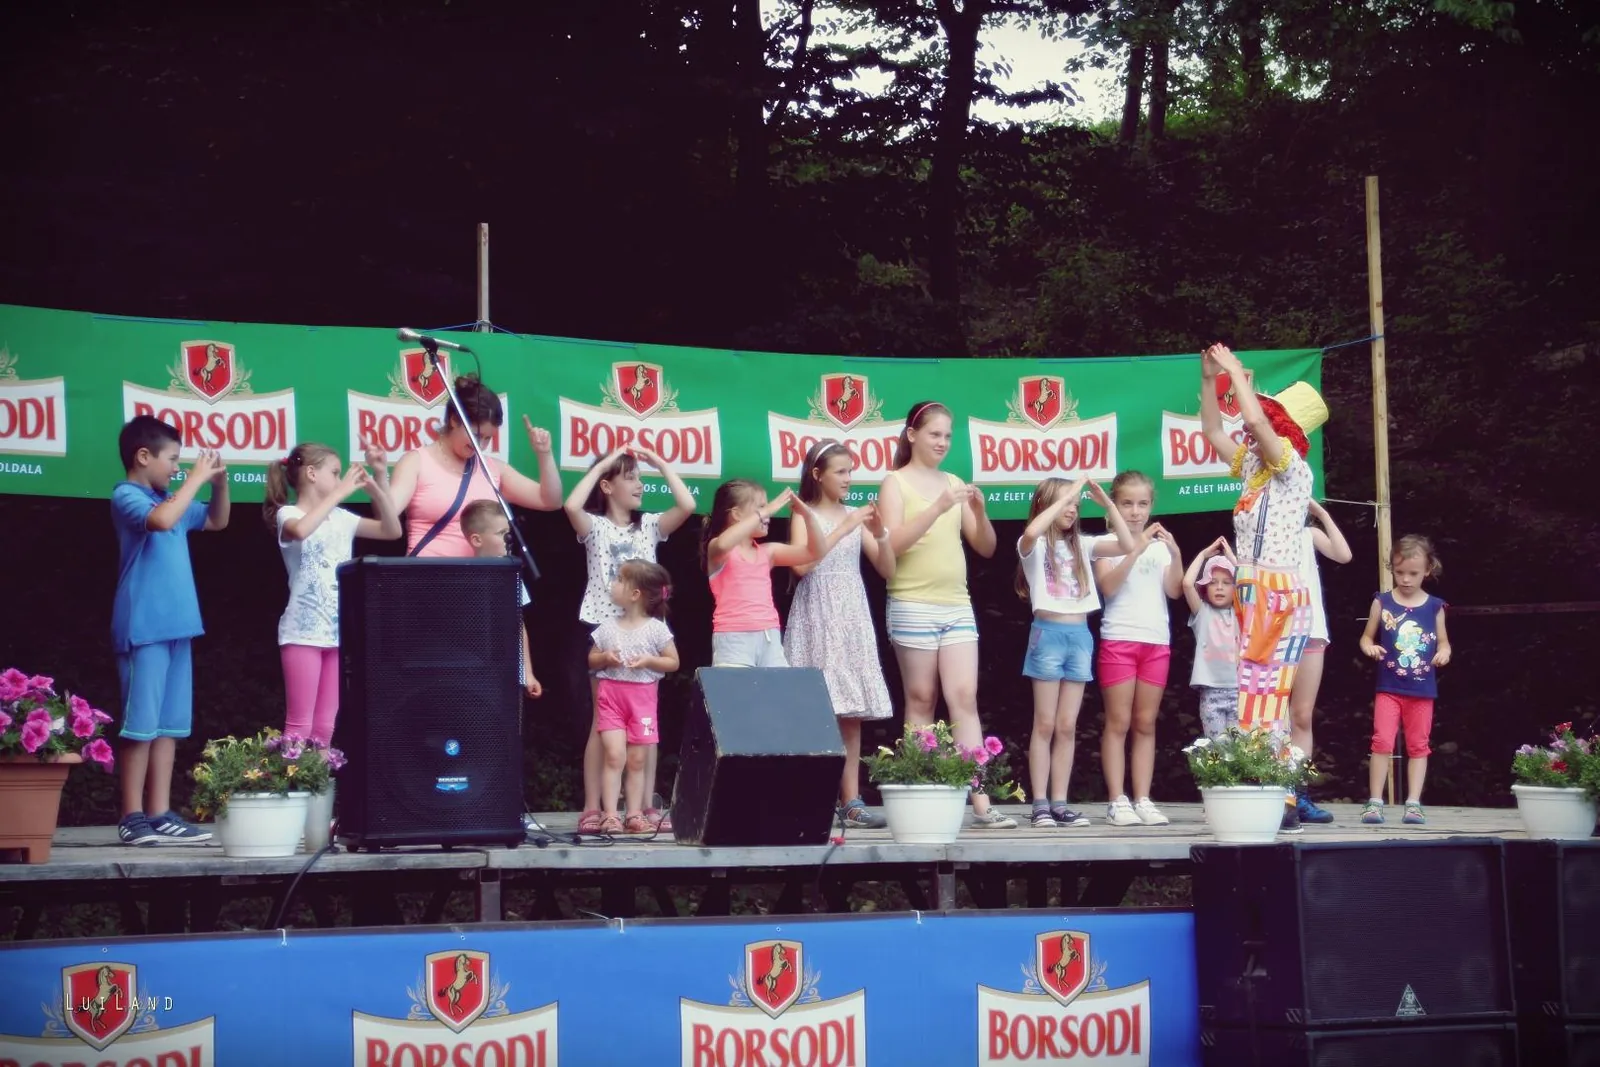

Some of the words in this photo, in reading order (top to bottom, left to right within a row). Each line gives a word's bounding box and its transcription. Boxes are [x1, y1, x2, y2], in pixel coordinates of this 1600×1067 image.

[978, 430, 1109, 472] BORSODI
[233, 472, 268, 483] OLDAL
[1179, 486, 1191, 495] AZ
[1194, 484, 1214, 494] ÉLET
[988, 492, 1000, 501] AZ
[1004, 491, 1026, 501] ÉLET
[692, 1014, 856, 1067] BORSODI
[988, 1004, 1142, 1061] BORSODI
